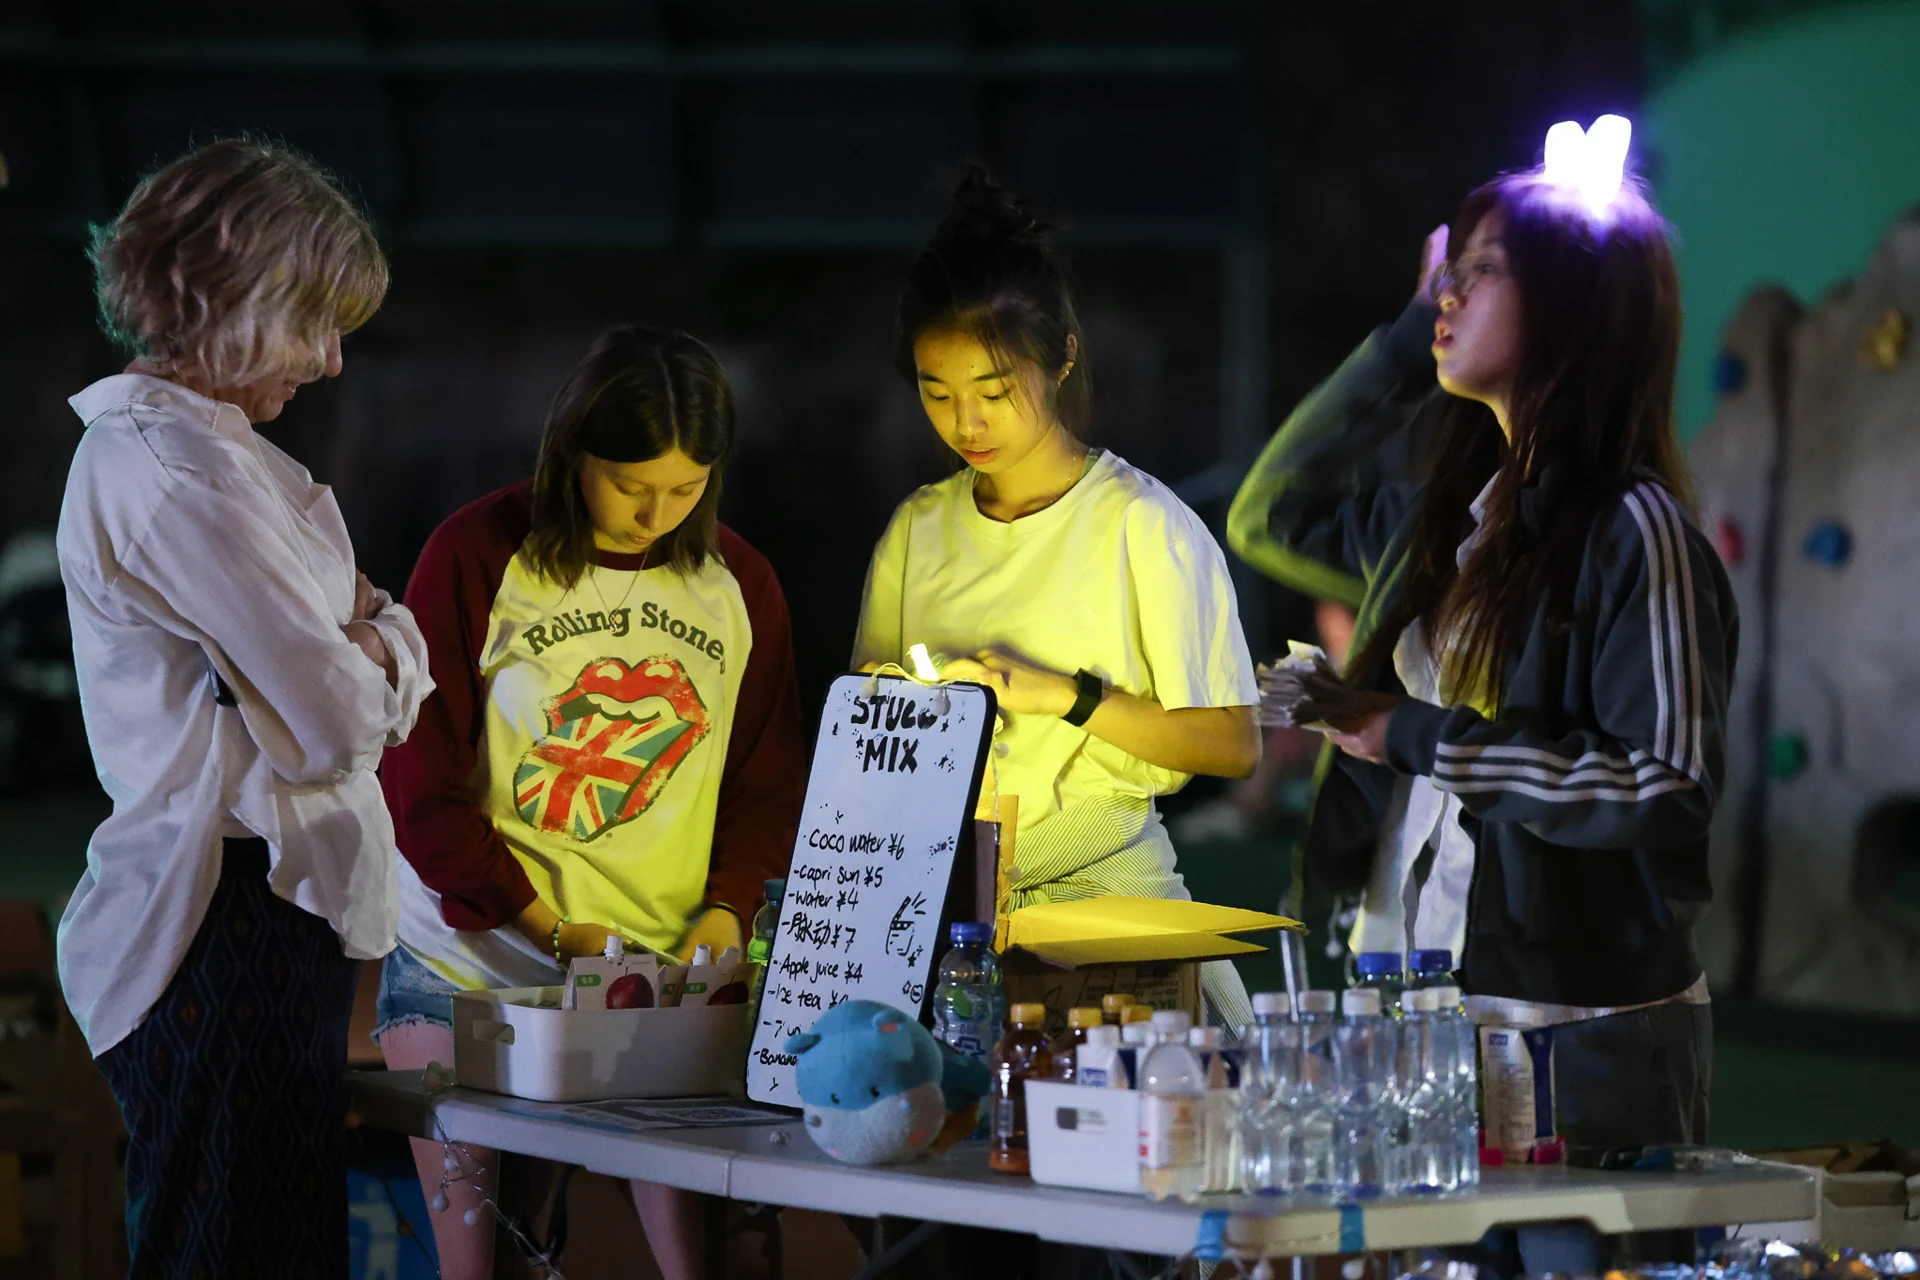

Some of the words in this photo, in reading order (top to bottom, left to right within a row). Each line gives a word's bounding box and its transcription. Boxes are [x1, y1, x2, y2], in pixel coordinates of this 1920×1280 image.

[522, 608, 631, 655] Rolling
[863, 736, 919, 774] MIX
[809, 828, 845, 853] Coco
[849, 832, 886, 854] water
[888, 833, 905, 860] ¥6
[864, 866, 884, 888] ¥5
[836, 887, 859, 912] ¥4
[810, 961, 839, 984] juice
[844, 961, 863, 985] ¥4
[797, 989, 821, 1010] tea
